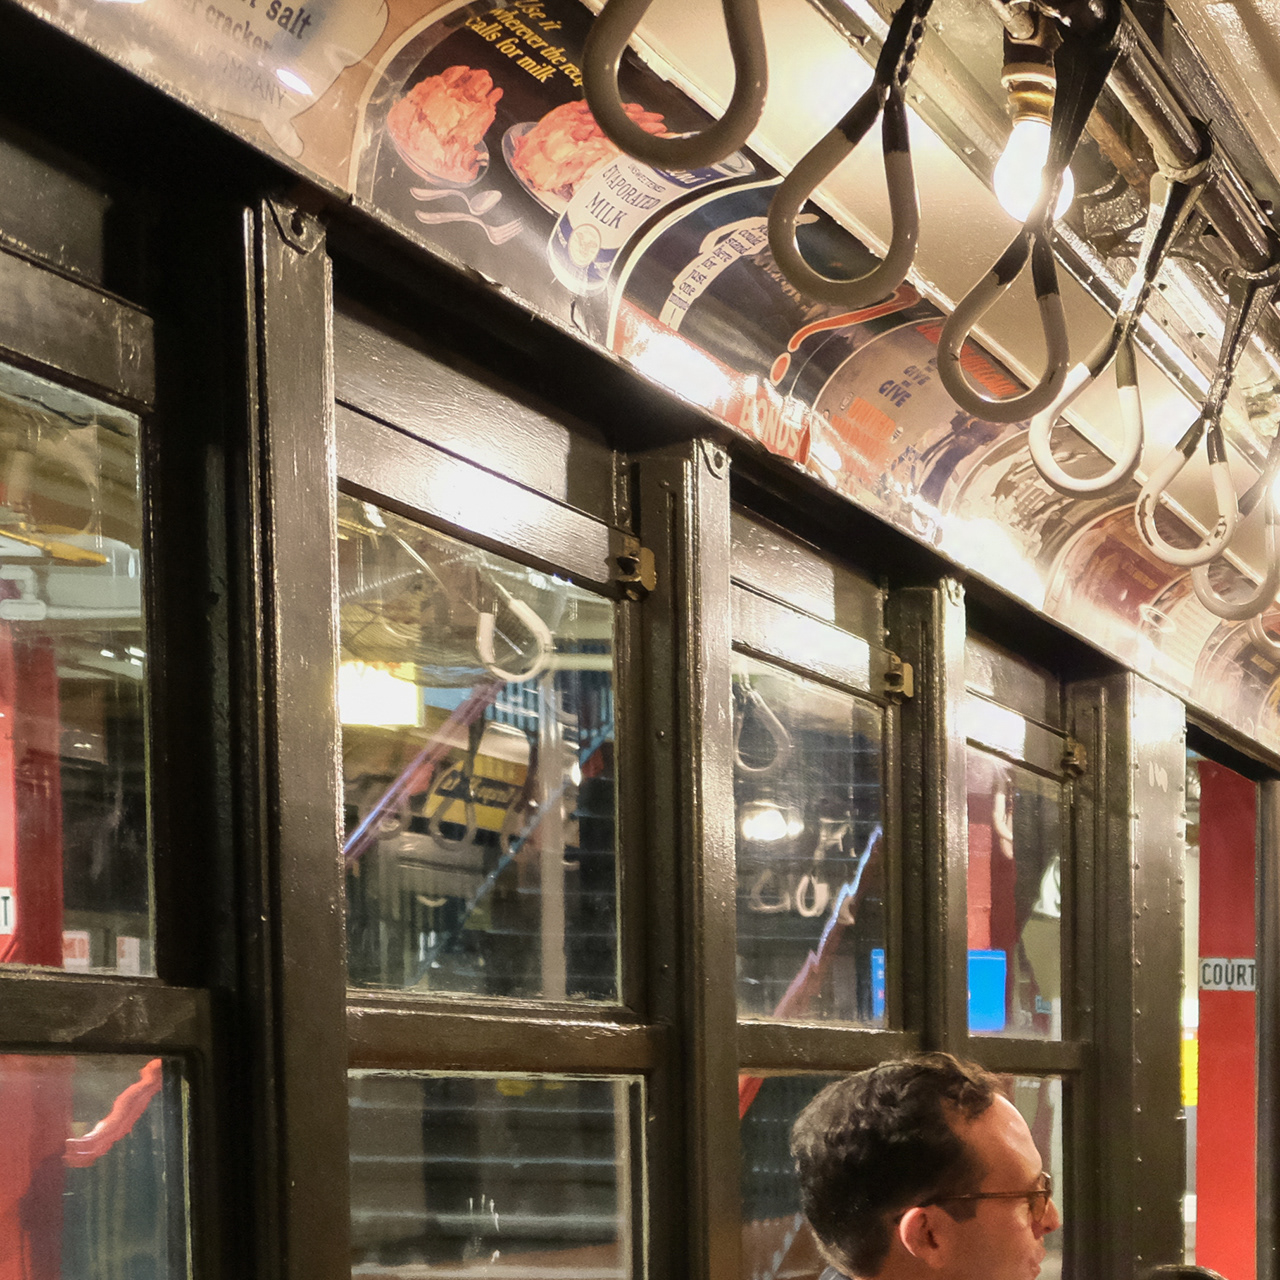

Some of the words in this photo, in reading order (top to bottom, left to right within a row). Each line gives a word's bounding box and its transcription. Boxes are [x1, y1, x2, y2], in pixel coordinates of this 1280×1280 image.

[206, 4, 273, 53] cracker
[490, 8, 548, 49] wherever
[540, 46, 567, 65] the
[539, 20, 562, 31] it
[465, 16, 503, 42] calls
[496, 37, 523, 58] for
[516, 55, 556, 83] milk
[602, 165, 661, 210] EVAPORATED
[585, 192, 628, 229] MILK
[726, 237, 752, 254] stand
[739, 229, 766, 245] could
[701, 256, 718, 270] for
[712, 245, 732, 262] here
[686, 266, 708, 285] just
[679, 282, 697, 296] one
[903, 364, 931, 387] GIVE
[879, 379, 912, 408] GIVE
[739, 398, 799, 457] BONDS
[1202, 963, 1255, 985] COURT
